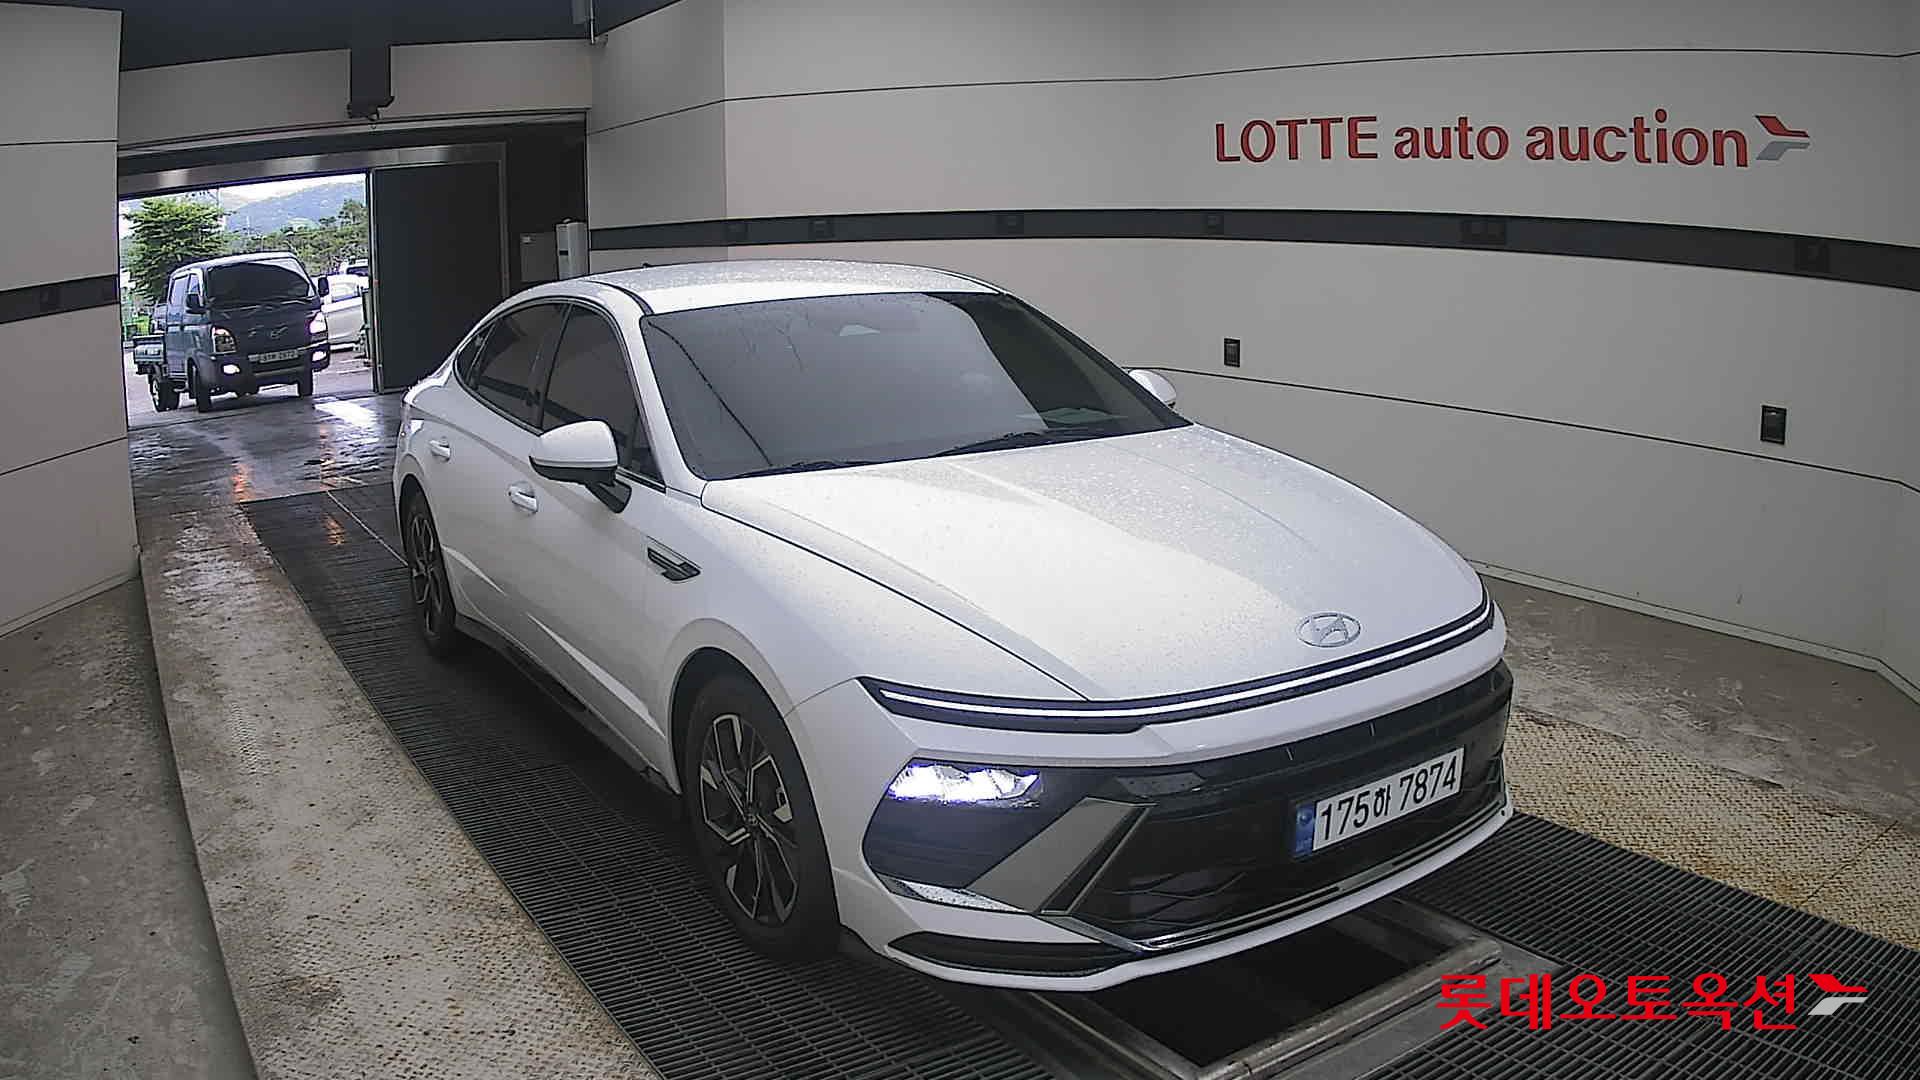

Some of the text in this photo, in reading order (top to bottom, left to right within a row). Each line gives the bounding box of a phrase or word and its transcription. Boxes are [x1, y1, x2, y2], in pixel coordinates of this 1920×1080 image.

[1215, 109, 1749, 167] LOTTE auto auction
[1321, 756, 1457, 840] 175하 7874
